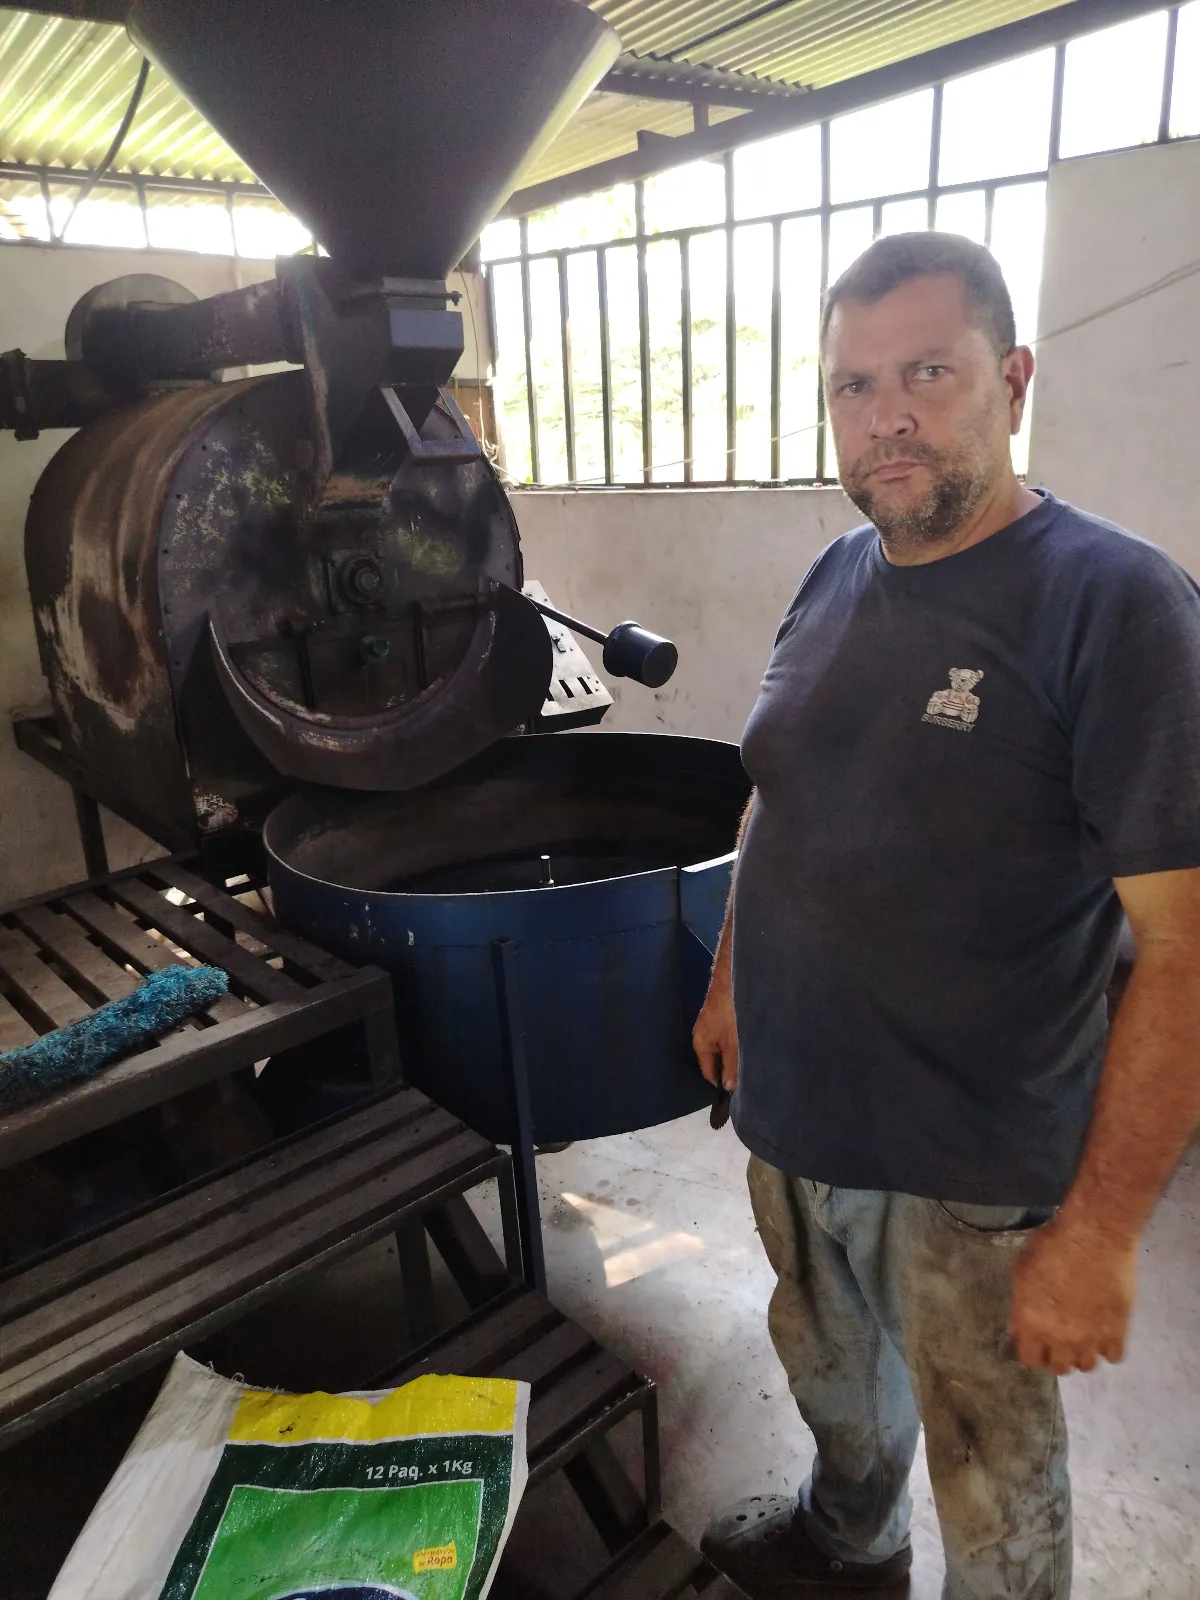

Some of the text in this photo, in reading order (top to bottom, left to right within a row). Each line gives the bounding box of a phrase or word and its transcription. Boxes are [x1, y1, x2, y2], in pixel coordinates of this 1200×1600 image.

[921, 713, 975, 732] BURBERRY
[365, 1459, 473, 1481] 12 Paq. x 1Kg
[427, 1556, 453, 1567] Ropa
